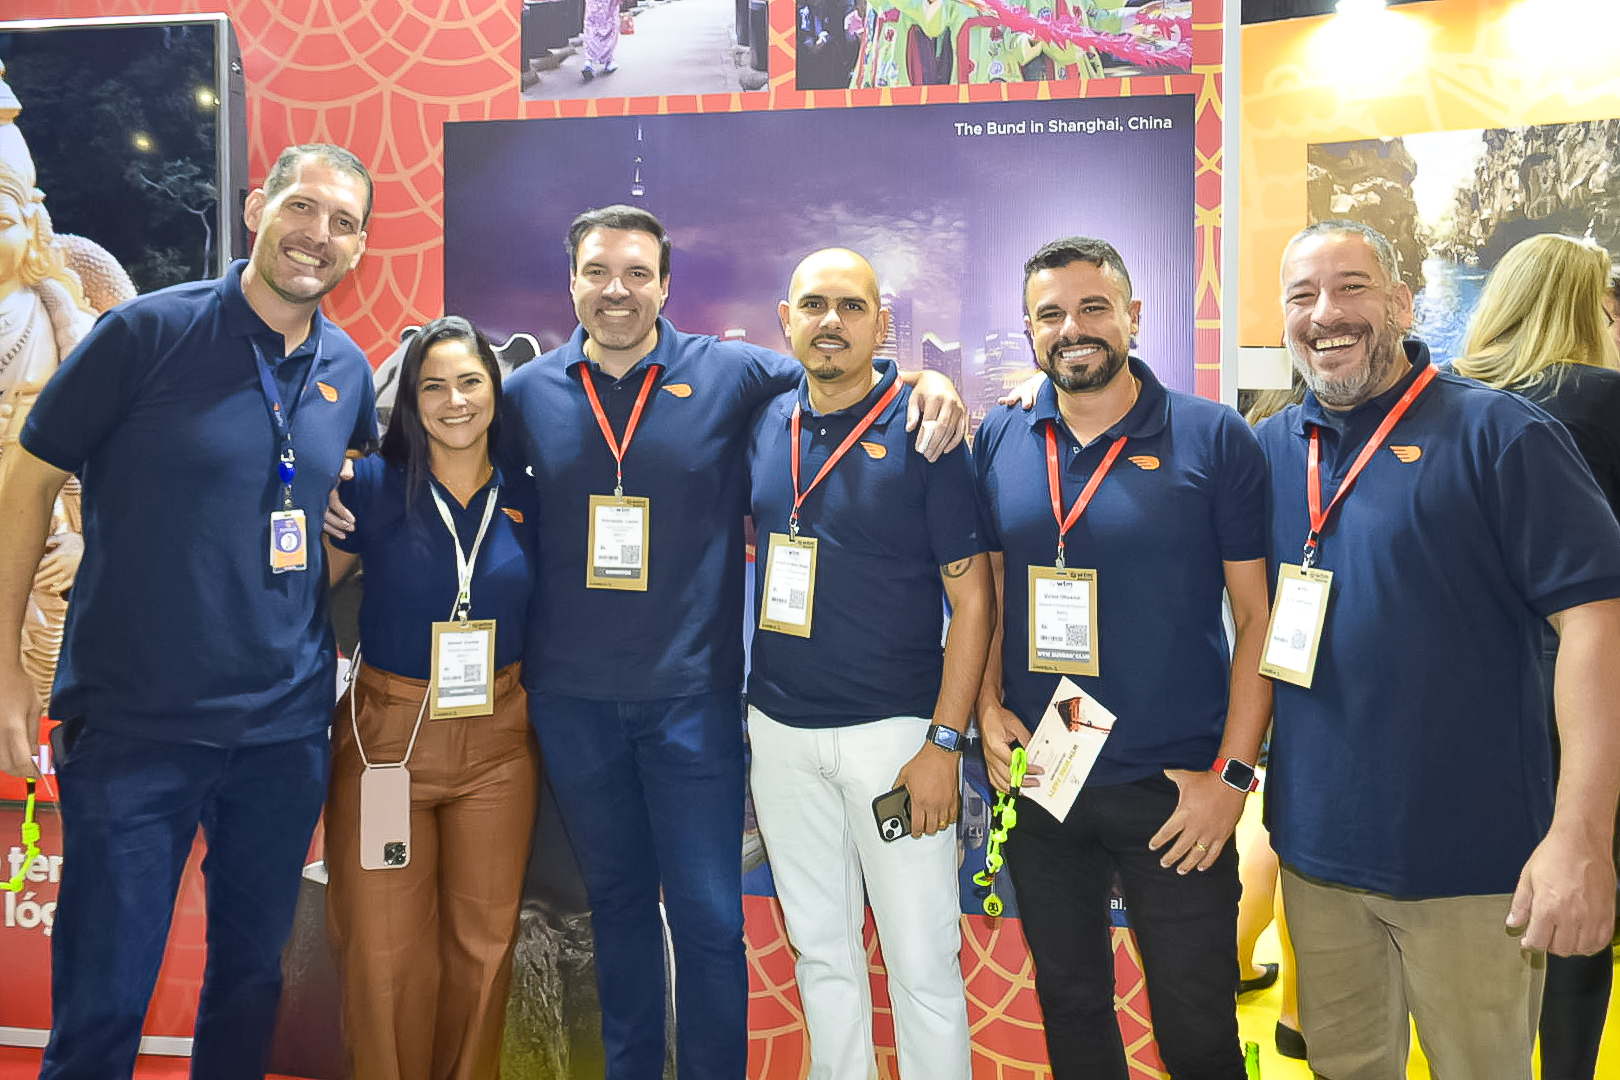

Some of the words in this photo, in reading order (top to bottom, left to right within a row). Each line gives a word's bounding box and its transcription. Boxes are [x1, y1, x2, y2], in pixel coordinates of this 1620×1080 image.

[954, 122, 983, 136] The
[987, 121, 1026, 135] Bund
[1030, 119, 1044, 133] in
[1048, 117, 1124, 134] Shanghai,
[1127, 115, 1173, 130] China
